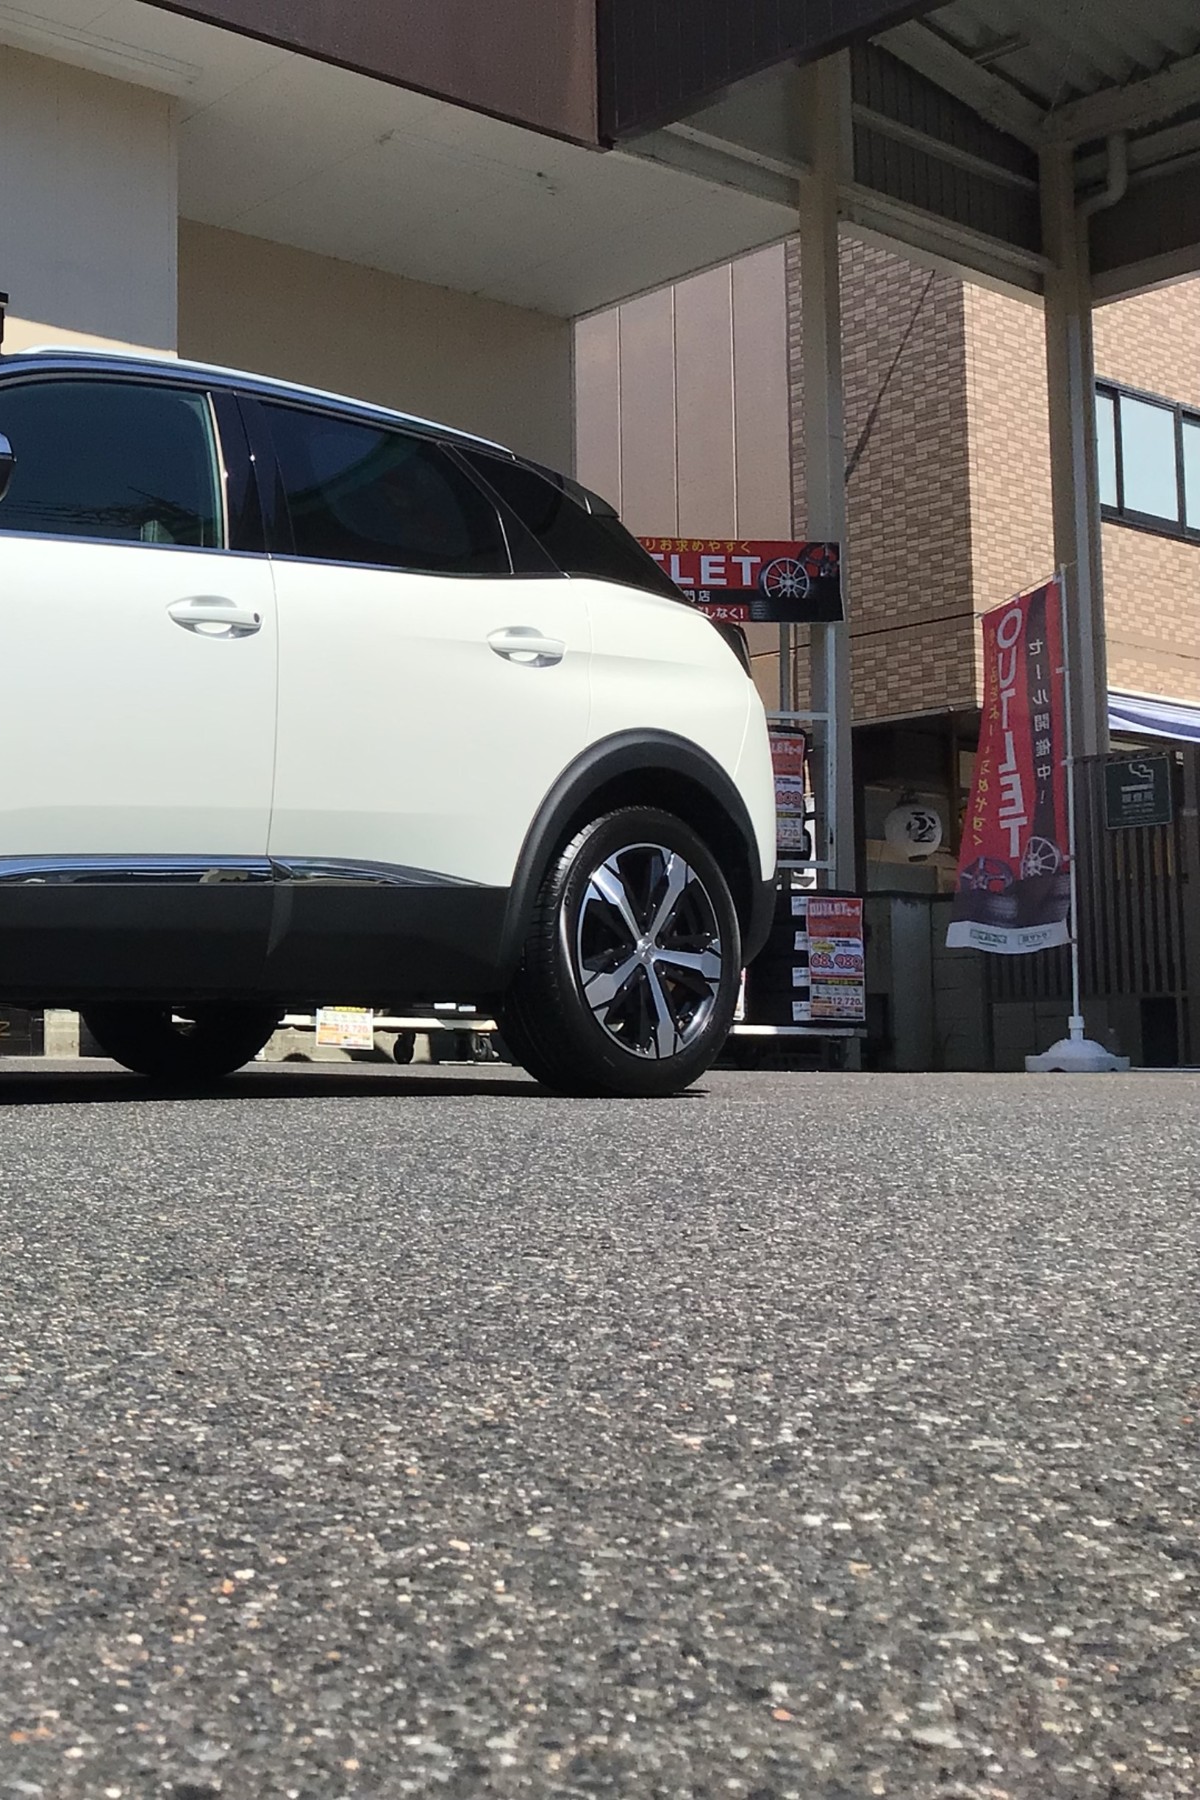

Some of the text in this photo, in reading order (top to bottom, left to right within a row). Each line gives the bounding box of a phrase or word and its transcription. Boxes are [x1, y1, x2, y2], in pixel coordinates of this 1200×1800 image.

[638, 538, 752, 554] りお求めやすく
